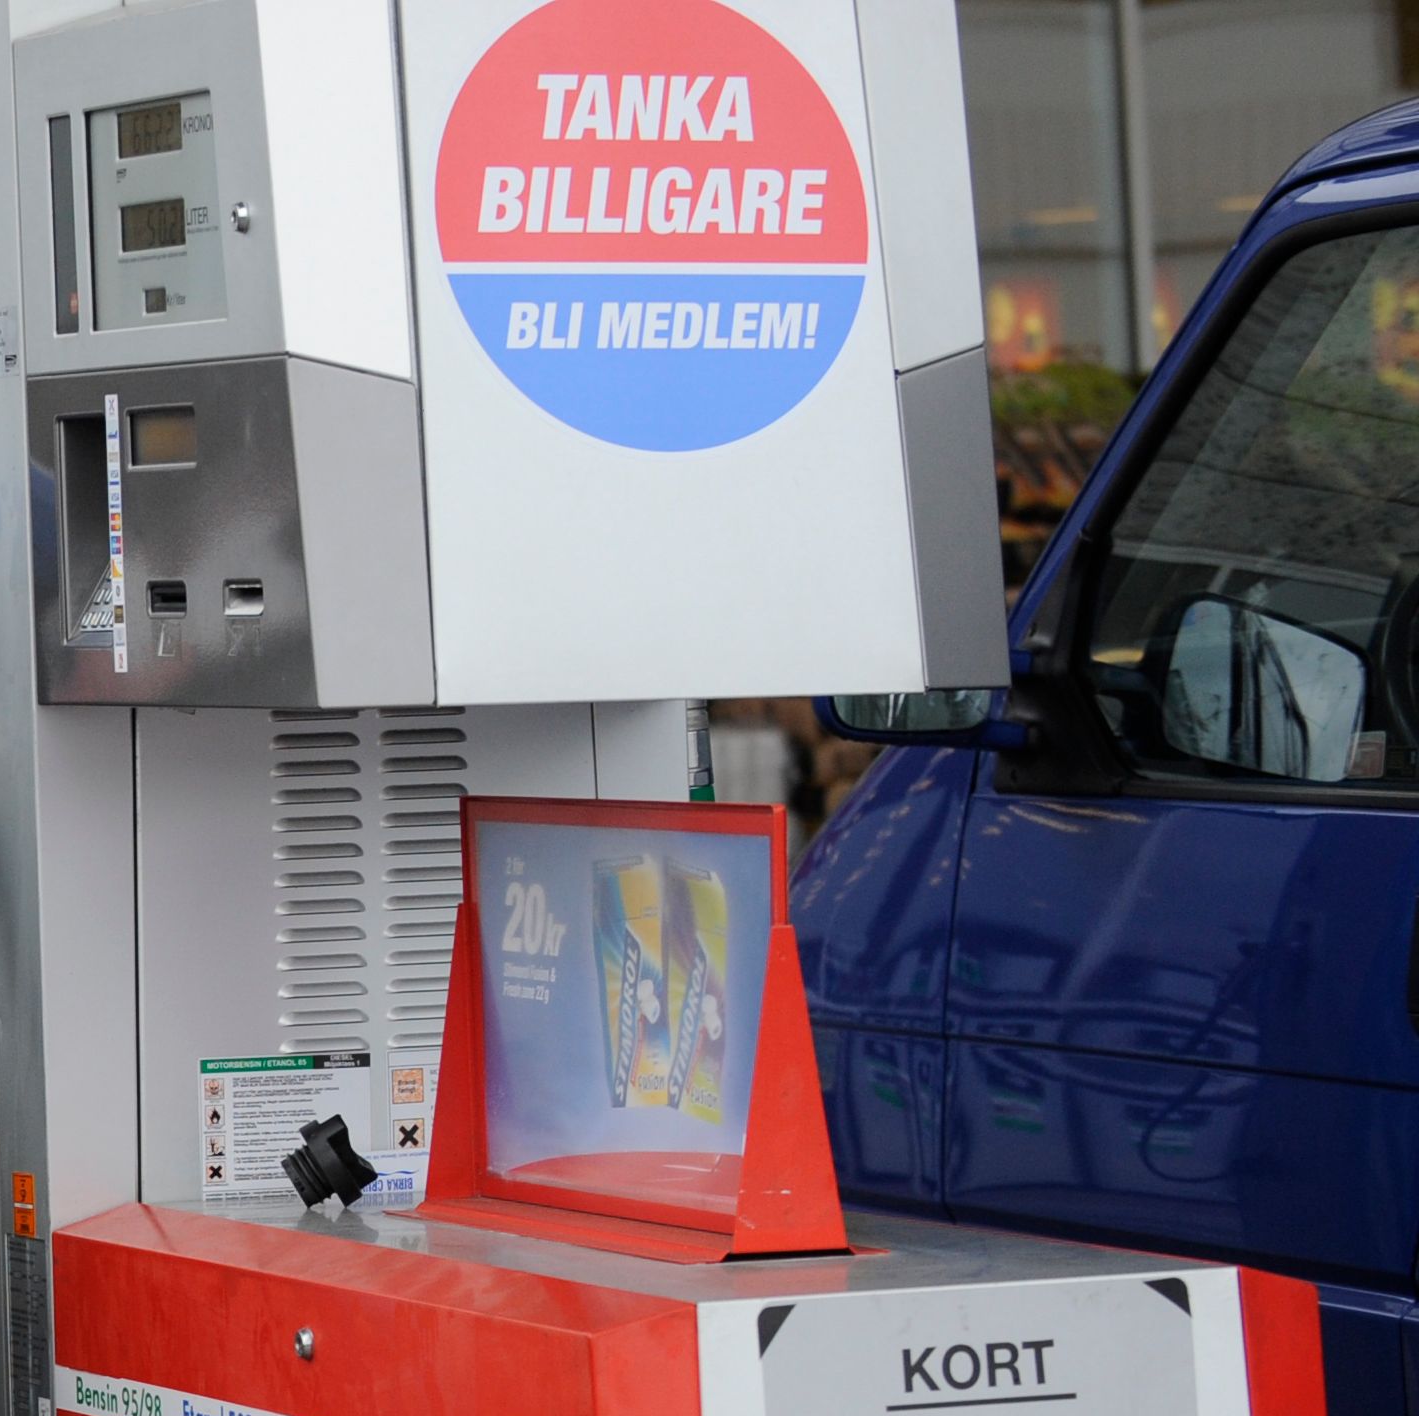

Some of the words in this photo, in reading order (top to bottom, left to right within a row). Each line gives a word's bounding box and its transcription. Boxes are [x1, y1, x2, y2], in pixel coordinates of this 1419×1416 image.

[536, 73, 754, 141] TANKA
[186, 206, 209, 226] LITER
[477, 166, 827, 235] BILLIGARE
[506, 302, 583, 350] BLI
[597, 302, 820, 350] MEDLEM!
[502, 881, 546, 955] 20
[544, 912, 567, 957] kr
[614, 944, 640, 1100] STIMOROL
[668, 954, 706, 1103] STIMOROL
[75, 1375, 119, 1416] Bensin
[902, 1339, 1056, 1393] KORT
